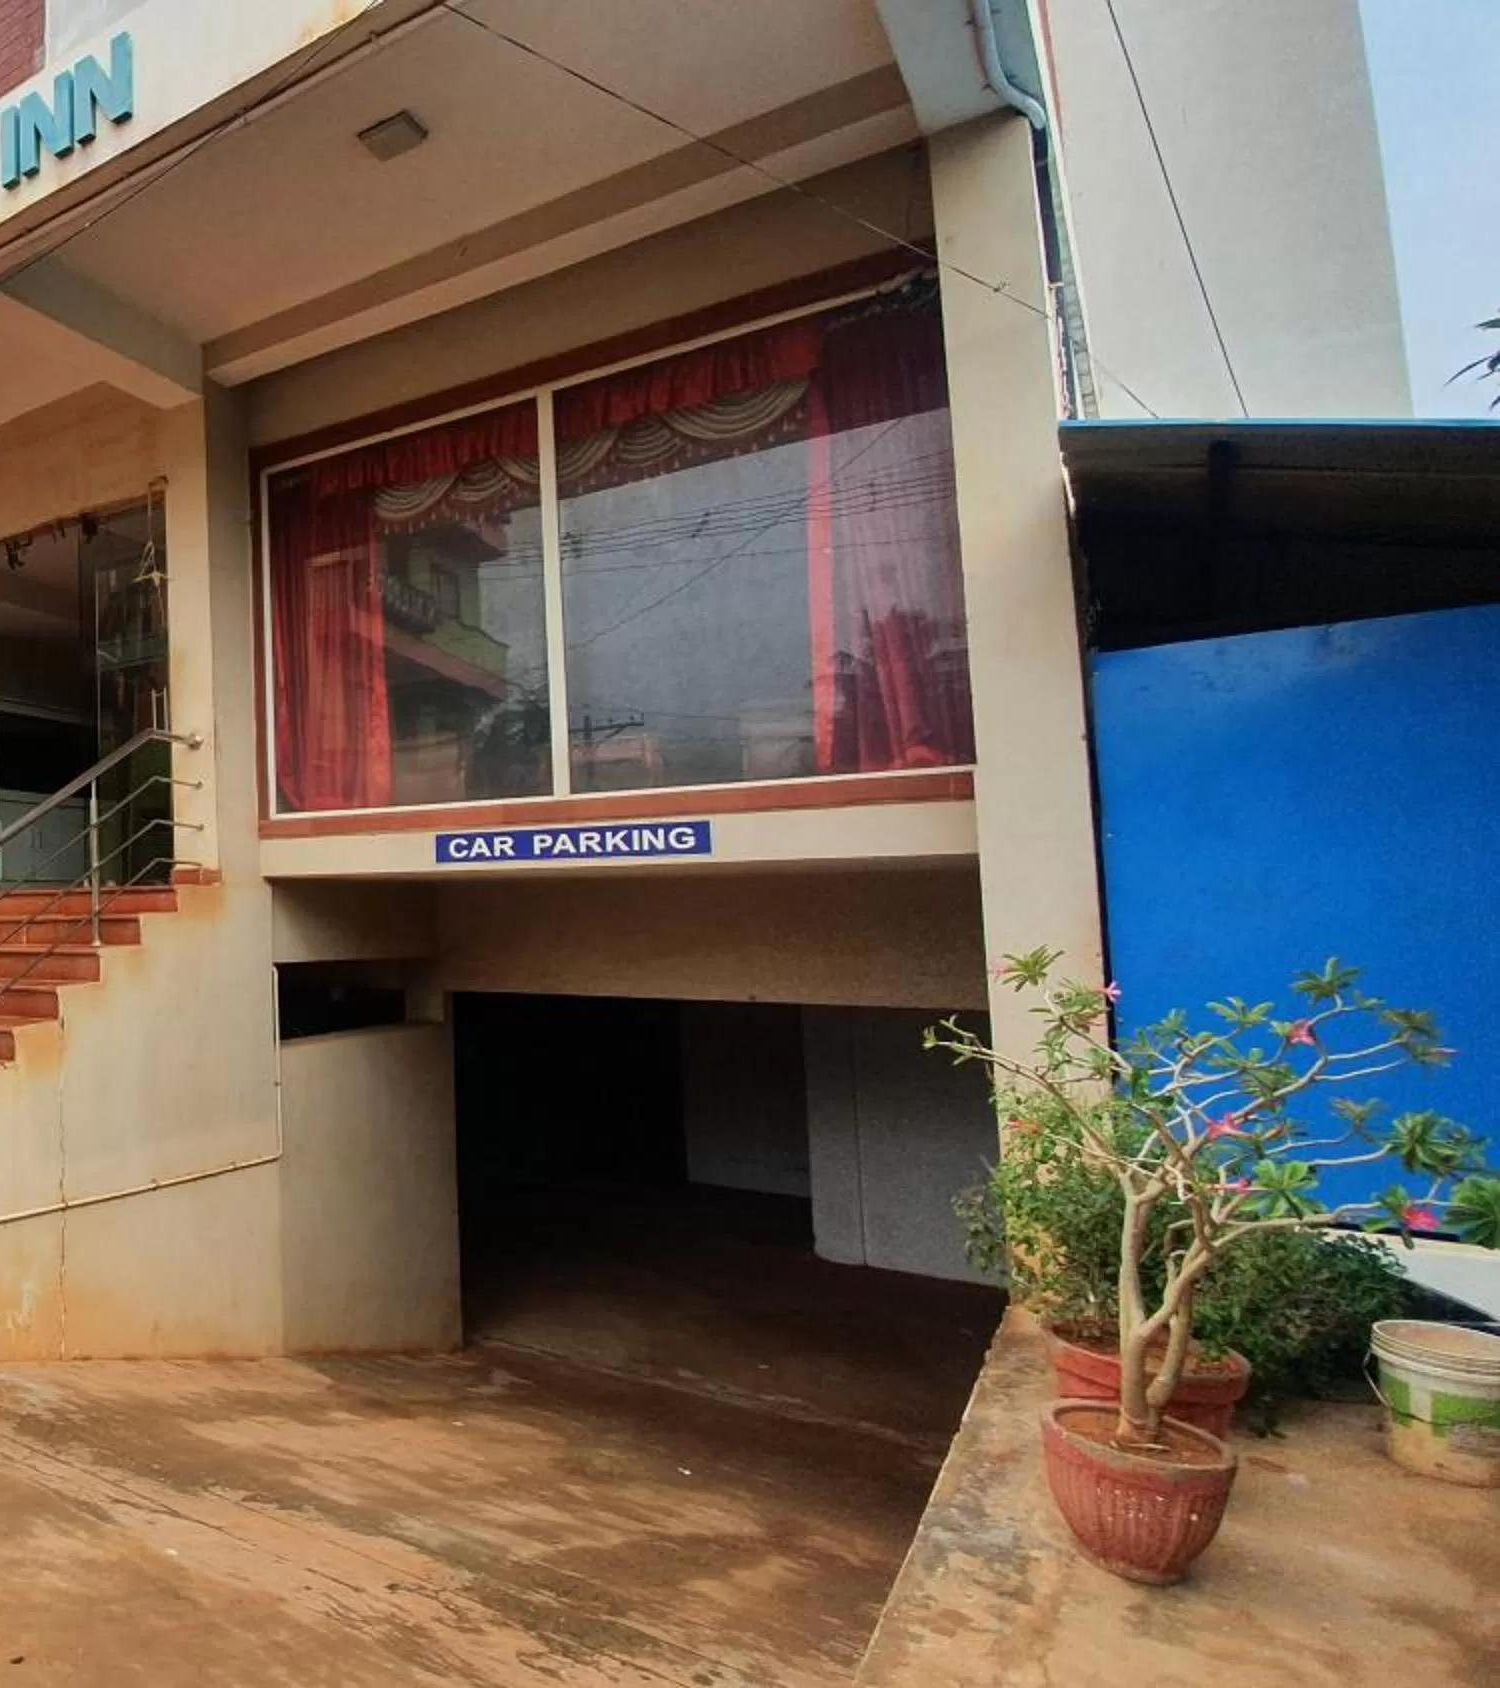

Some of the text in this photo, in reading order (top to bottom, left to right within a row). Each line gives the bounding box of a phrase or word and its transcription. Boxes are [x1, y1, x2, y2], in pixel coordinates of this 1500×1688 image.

[0, 31, 134, 190] INN
[448, 827, 697, 858] CAR PARKING
